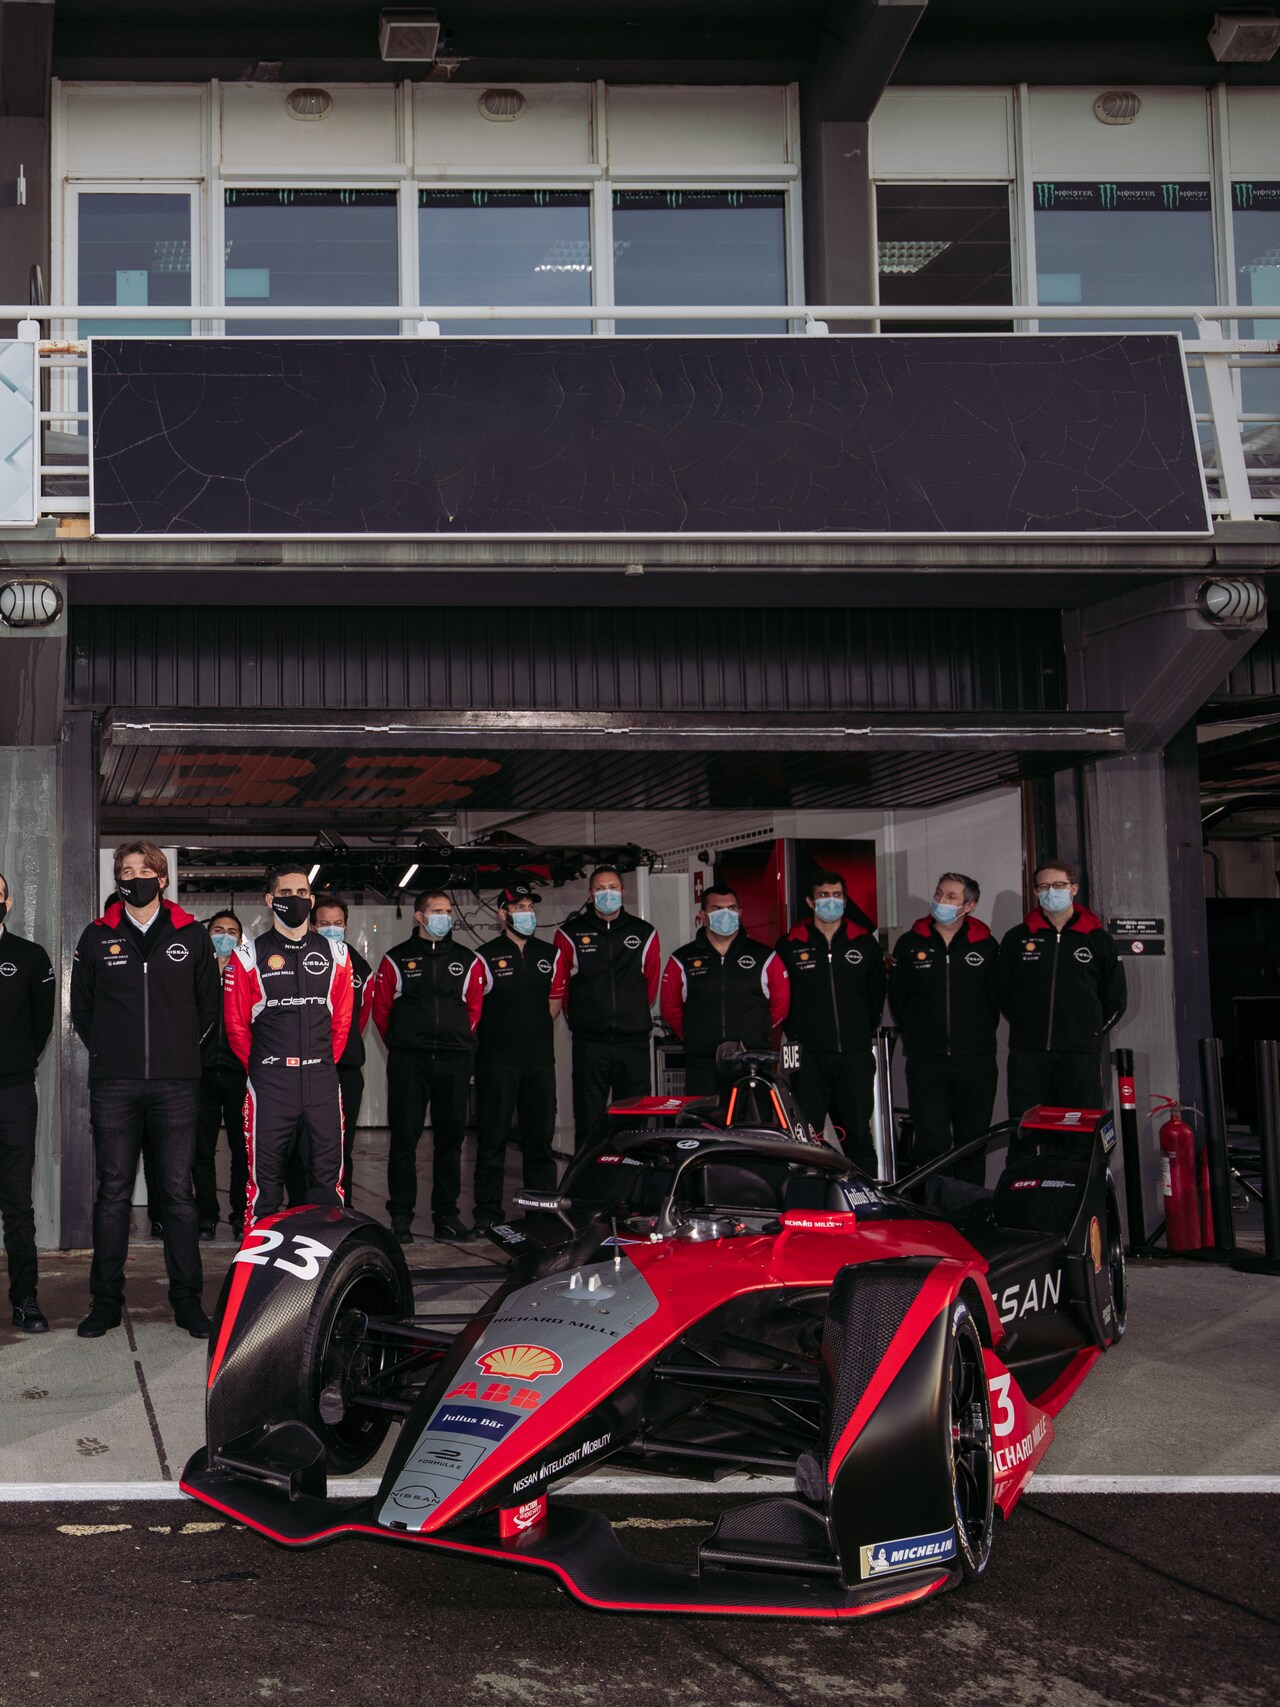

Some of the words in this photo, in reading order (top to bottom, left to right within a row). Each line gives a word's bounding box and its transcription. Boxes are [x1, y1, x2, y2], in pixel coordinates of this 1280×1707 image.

[1180, 189, 1208, 197] MONST
[267, 997, 326, 1008] e.dams
[783, 1045, 800, 1068] BUE
[232, 1229, 333, 1280] 23
[992, 1269, 1061, 1323] SAN
[493, 1315, 564, 1325] RICHARD
[569, 1320, 620, 1338] MILLE
[444, 1381, 542, 1410] ABB
[989, 1373, 1015, 1437] 3
[442, 1413, 477, 1425] Julius
[479, 1418, 504, 1430] Bär
[418, 1458, 455, 1468] FORMULA
[513, 1474, 538, 1494] NISSAN
[540, 1447, 581, 1479] INTELLIGENT
[390, 1490, 441, 1504] NISSAN
[891, 1538, 953, 1563] MICHELIN
